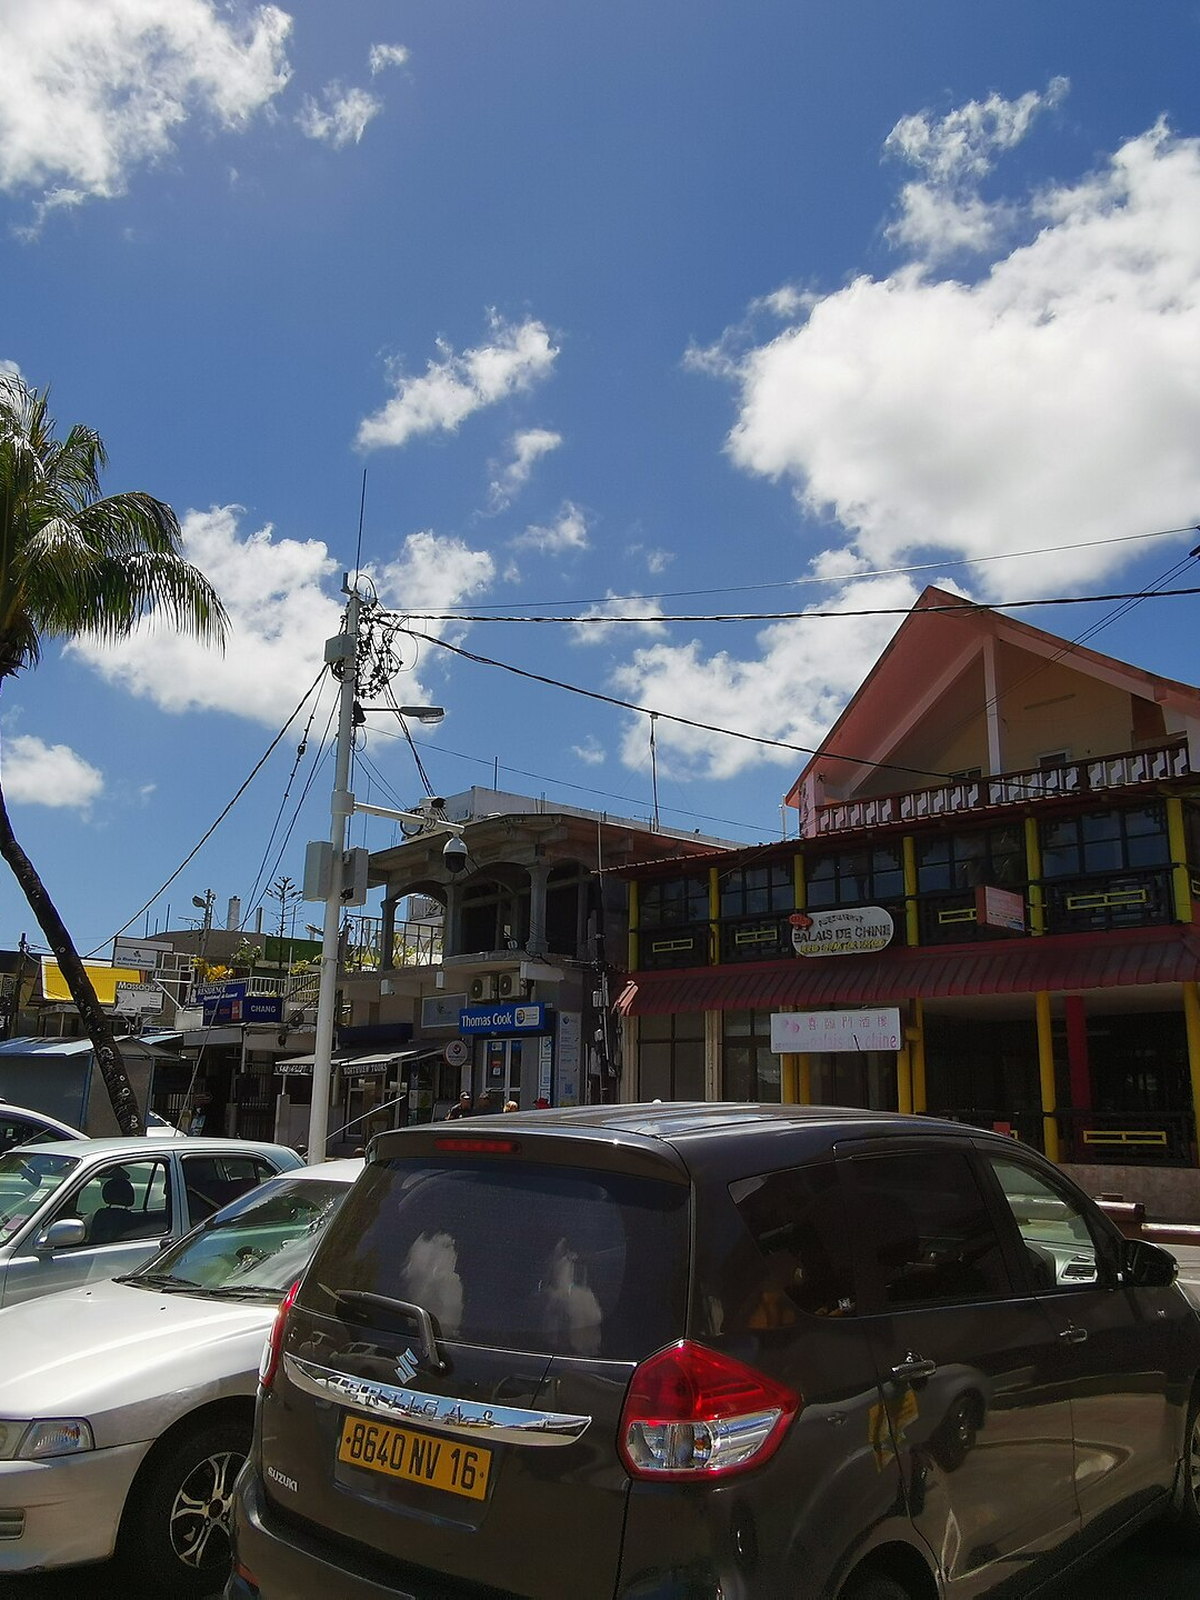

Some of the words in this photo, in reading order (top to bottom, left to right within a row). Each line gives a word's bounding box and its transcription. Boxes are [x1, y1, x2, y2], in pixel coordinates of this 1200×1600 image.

[835, 928, 852, 940] DE
[855, 924, 891, 938] CHINE
[250, 1004, 277, 1013] CHANG
[461, 1014, 492, 1027] Thomas
[492, 1012, 512, 1026] Cook
[865, 1031, 898, 1049] chine
[349, 1423, 405, 1470] 8640
[408, 1436, 442, 1480] NV
[450, 1449, 479, 1490] 16
[267, 1466, 299, 1493] SUZUKI
